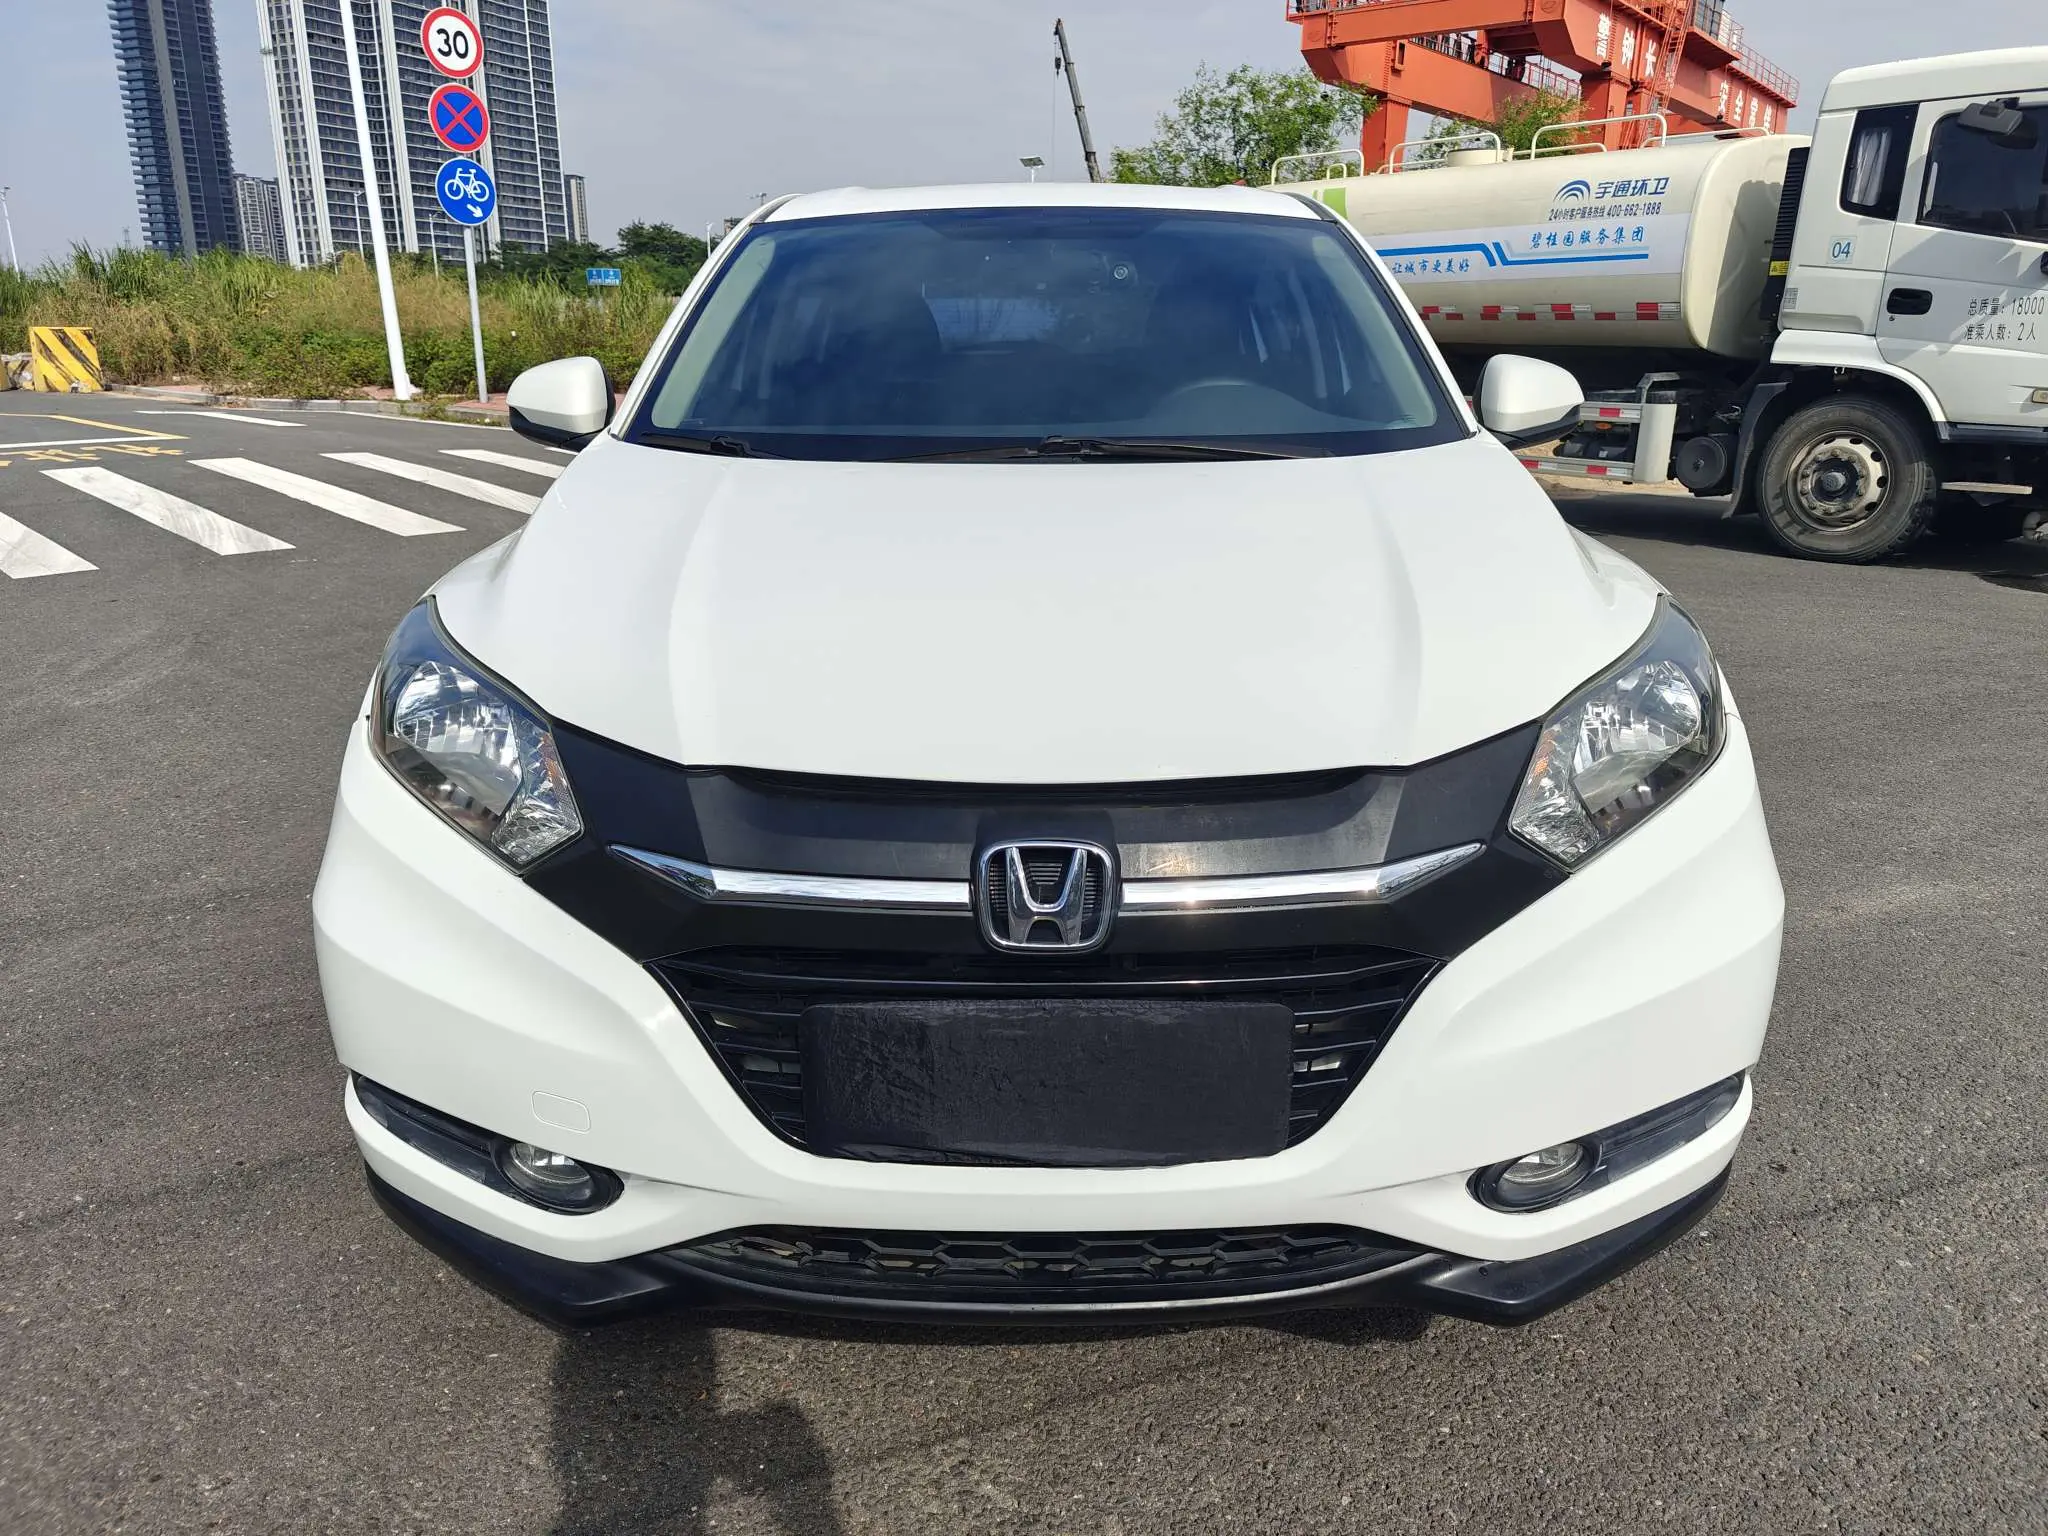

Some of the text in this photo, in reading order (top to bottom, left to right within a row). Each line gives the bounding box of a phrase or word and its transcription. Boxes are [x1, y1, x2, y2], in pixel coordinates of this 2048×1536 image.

[436, 27, 469, 59] 30
[1595, 177, 1670, 199] 宇通环卫
[1530, 225, 1644, 249] 碧桂园服务集团
[1832, 241, 1851, 259] 04
[1391, 257, 1471, 275] 让城市更美好
